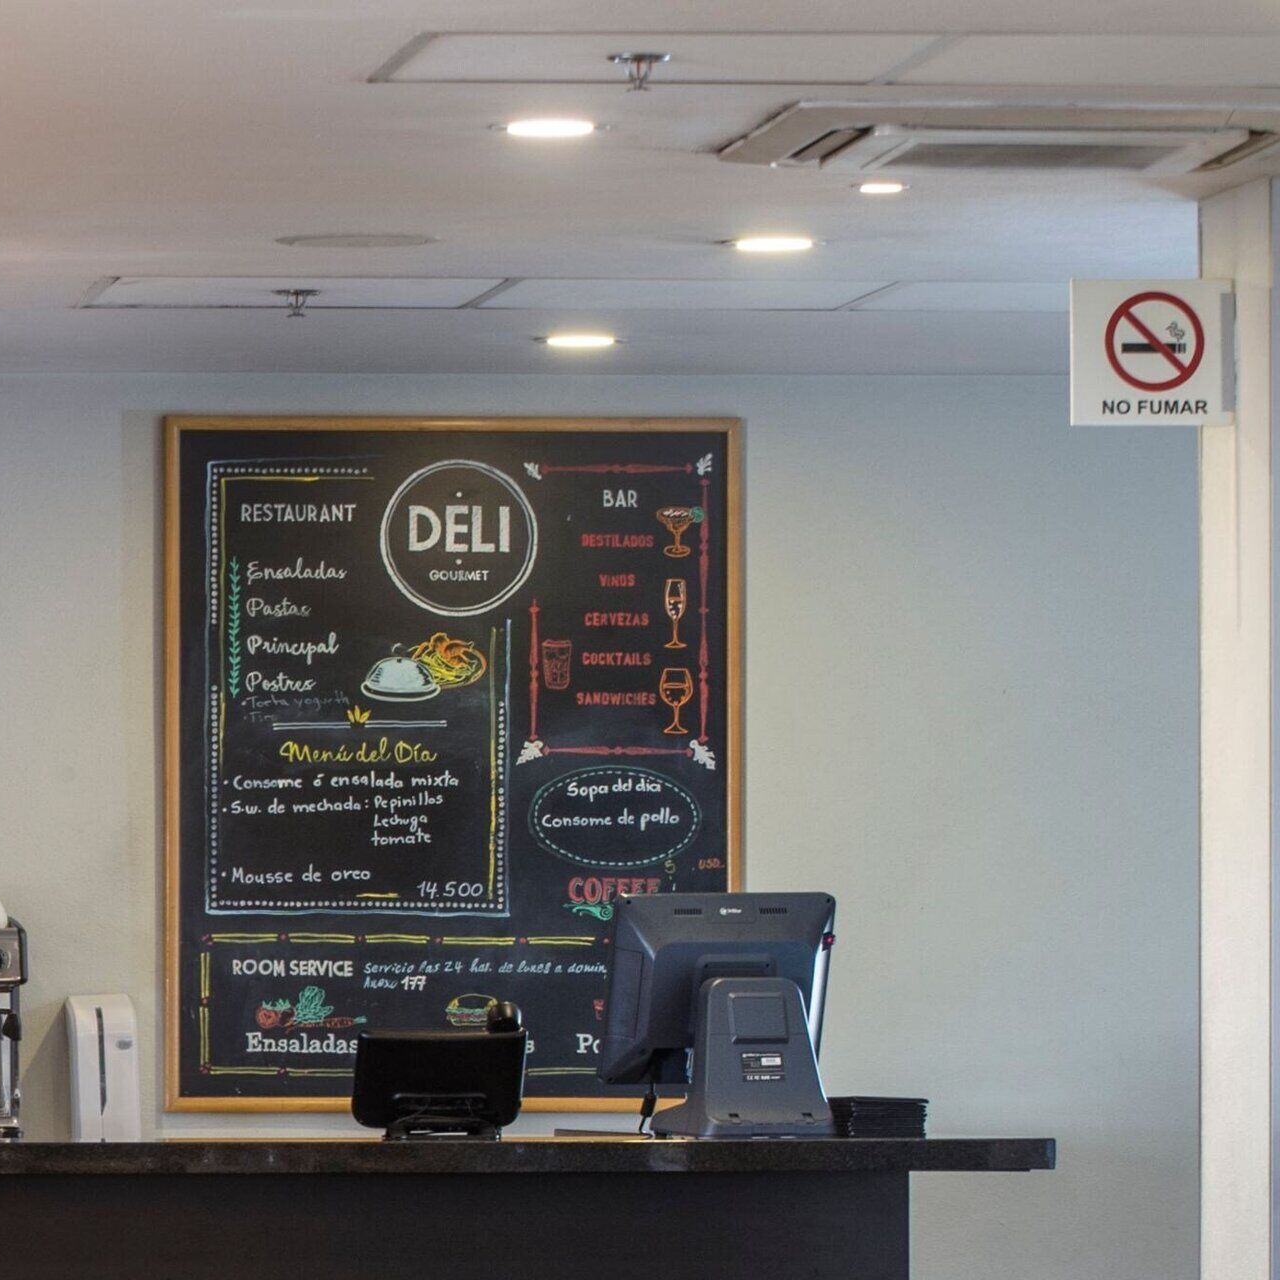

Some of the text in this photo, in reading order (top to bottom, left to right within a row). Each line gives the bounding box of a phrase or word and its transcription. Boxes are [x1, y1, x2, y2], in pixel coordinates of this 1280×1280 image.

[1102, 400, 1208, 415] NO FUMAR
[603, 489, 638, 508] BAR
[241, 503, 357, 522] RESTAURANT
[408, 504, 511, 553] DELI
[581, 534, 654, 548] DESTILADOS
[246, 556, 348, 585] Ensaladas
[429, 569, 490, 582] GOURMET
[598, 574, 636, 588] VINOS
[246, 597, 311, 618] Pastas
[584, 612, 650, 627] CERVEZAS
[246, 631, 340, 666] Principal
[581, 652, 652, 666] COCKTAILS
[245, 671, 317, 692] Postres
[576, 691, 657, 705] SANDWICHES
[355, 736, 391, 764] del
[233, 775, 303, 790] Consome
[330, 770, 404, 789] ensalada
[411, 769, 459, 788] mixta
[566, 781, 609, 802] Sopa
[612, 778, 632, 792] del
[268, 798, 286, 815] de
[374, 791, 444, 813] Pepinillos
[373, 814, 429, 832] Lechuga
[542, 806, 680, 832] Consome de pollo
[371, 829, 433, 847] tomate
[231, 866, 294, 885] Mousse
[302, 864, 322, 883] de
[416, 880, 484, 899] 14.500
[232, 959, 354, 977] ROOM SERVICE
[363, 961, 415, 974] Servicio
[443, 961, 463, 973] 24
[498, 962, 514, 974] de
[246, 1031, 359, 1054] Ensaladas
